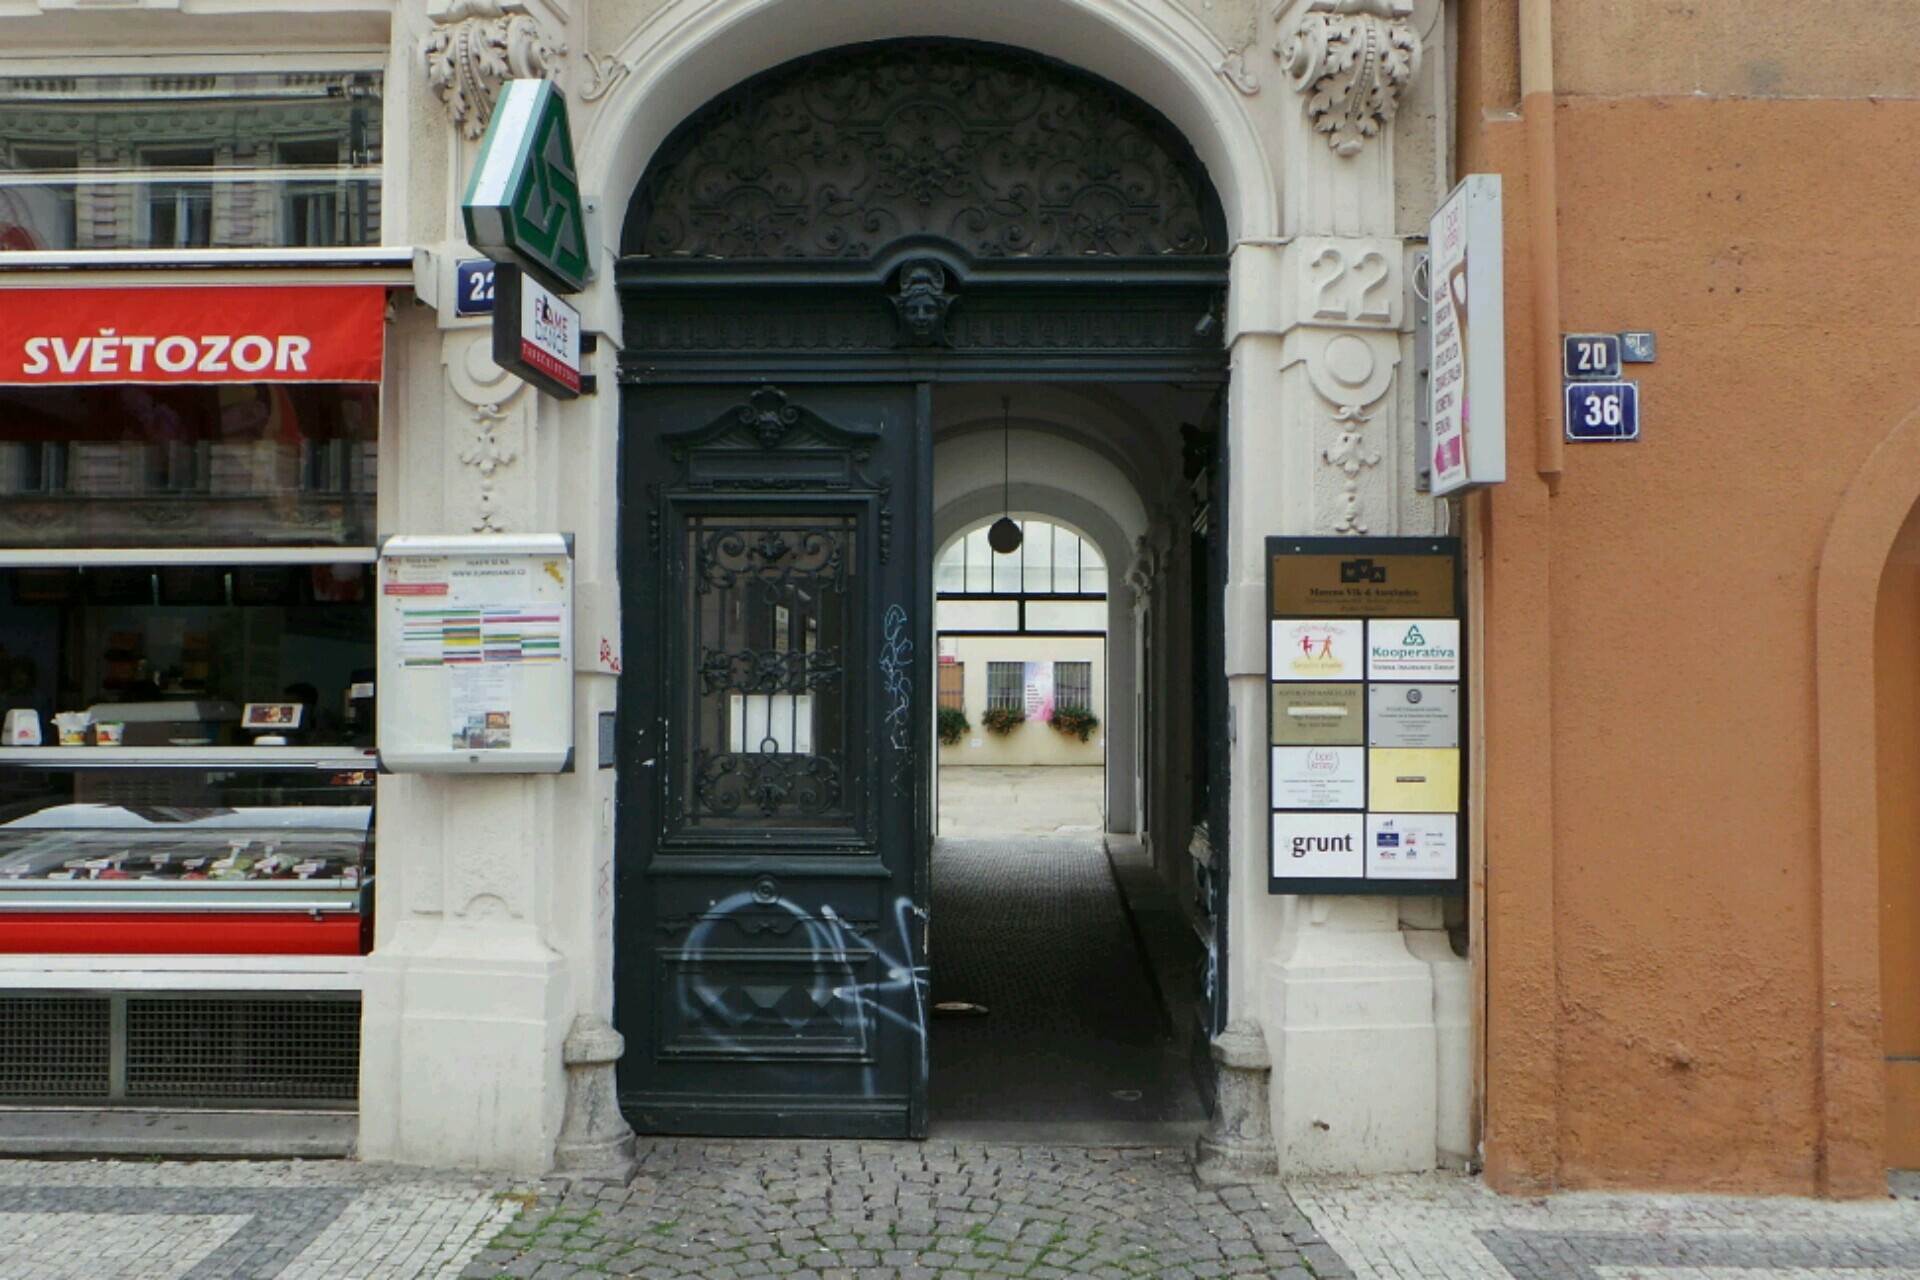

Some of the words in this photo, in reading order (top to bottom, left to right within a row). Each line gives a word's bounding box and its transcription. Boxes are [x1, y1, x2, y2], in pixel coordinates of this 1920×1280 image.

[1310, 247, 1391, 322] 22
[23, 328, 311, 374] SVĚTOZOR
[1577, 342, 1607, 370] 20
[1584, 394, 1621, 427] 36
[1372, 645, 1455, 661] Kooperativa
[1291, 833, 1354, 858] grunt
